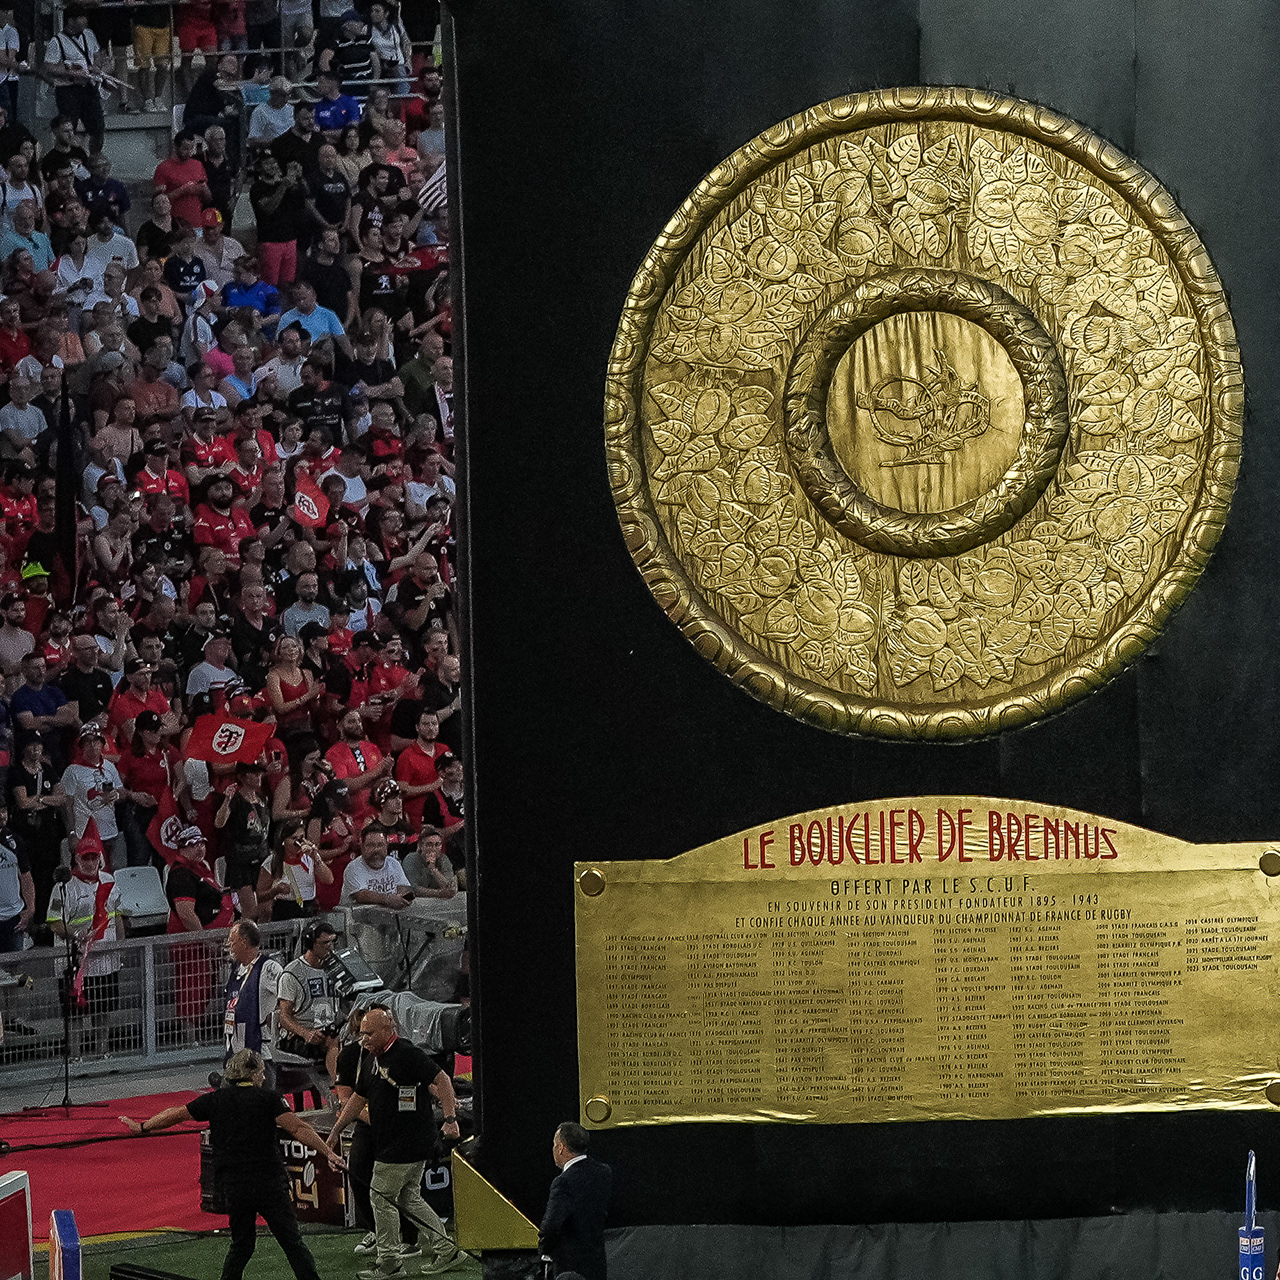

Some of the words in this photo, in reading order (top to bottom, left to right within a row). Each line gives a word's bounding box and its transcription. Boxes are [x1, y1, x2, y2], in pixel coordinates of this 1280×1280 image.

[744, 829, 775, 870] LE
[789, 808, 925, 868] BOUCLIER
[938, 808, 973, 863] DE
[988, 809, 1118, 862] BRENNUS
[831, 880, 893, 896] OFFERT
[903, 878, 933, 894] PAR
[942, 878, 959, 894] LE
[768, 901, 782, 912] EN
[786, 900, 841, 912] SOUVENIR
[847, 900, 862, 911] DE
[866, 898, 888, 910] SON
[893, 897, 953, 909] PRESIDENT
[959, 896, 1023, 909] FONDATEUR
[1030, 895, 1057, 906] 1895
[1072, 893, 1099, 905] 1943
[735, 917, 747, 928] ET
[750, 916, 784, 928] CONFIE
[788, 915, 826, 927] CHAQUE
[829, 914, 860, 925] ANNEE
[864, 914, 878, 925] AU
[880, 912, 935, 925] VAINQUEUR
[938, 912, 952, 924] DU
[955, 911, 1027, 923] CHAMPIONNAT
[1030, 910, 1043, 922] DE
[1045, 909, 1082, 921] FRANCE
[1085, 909, 1097, 920] DE
[1100, 908, 1131, 920] RUGBY
